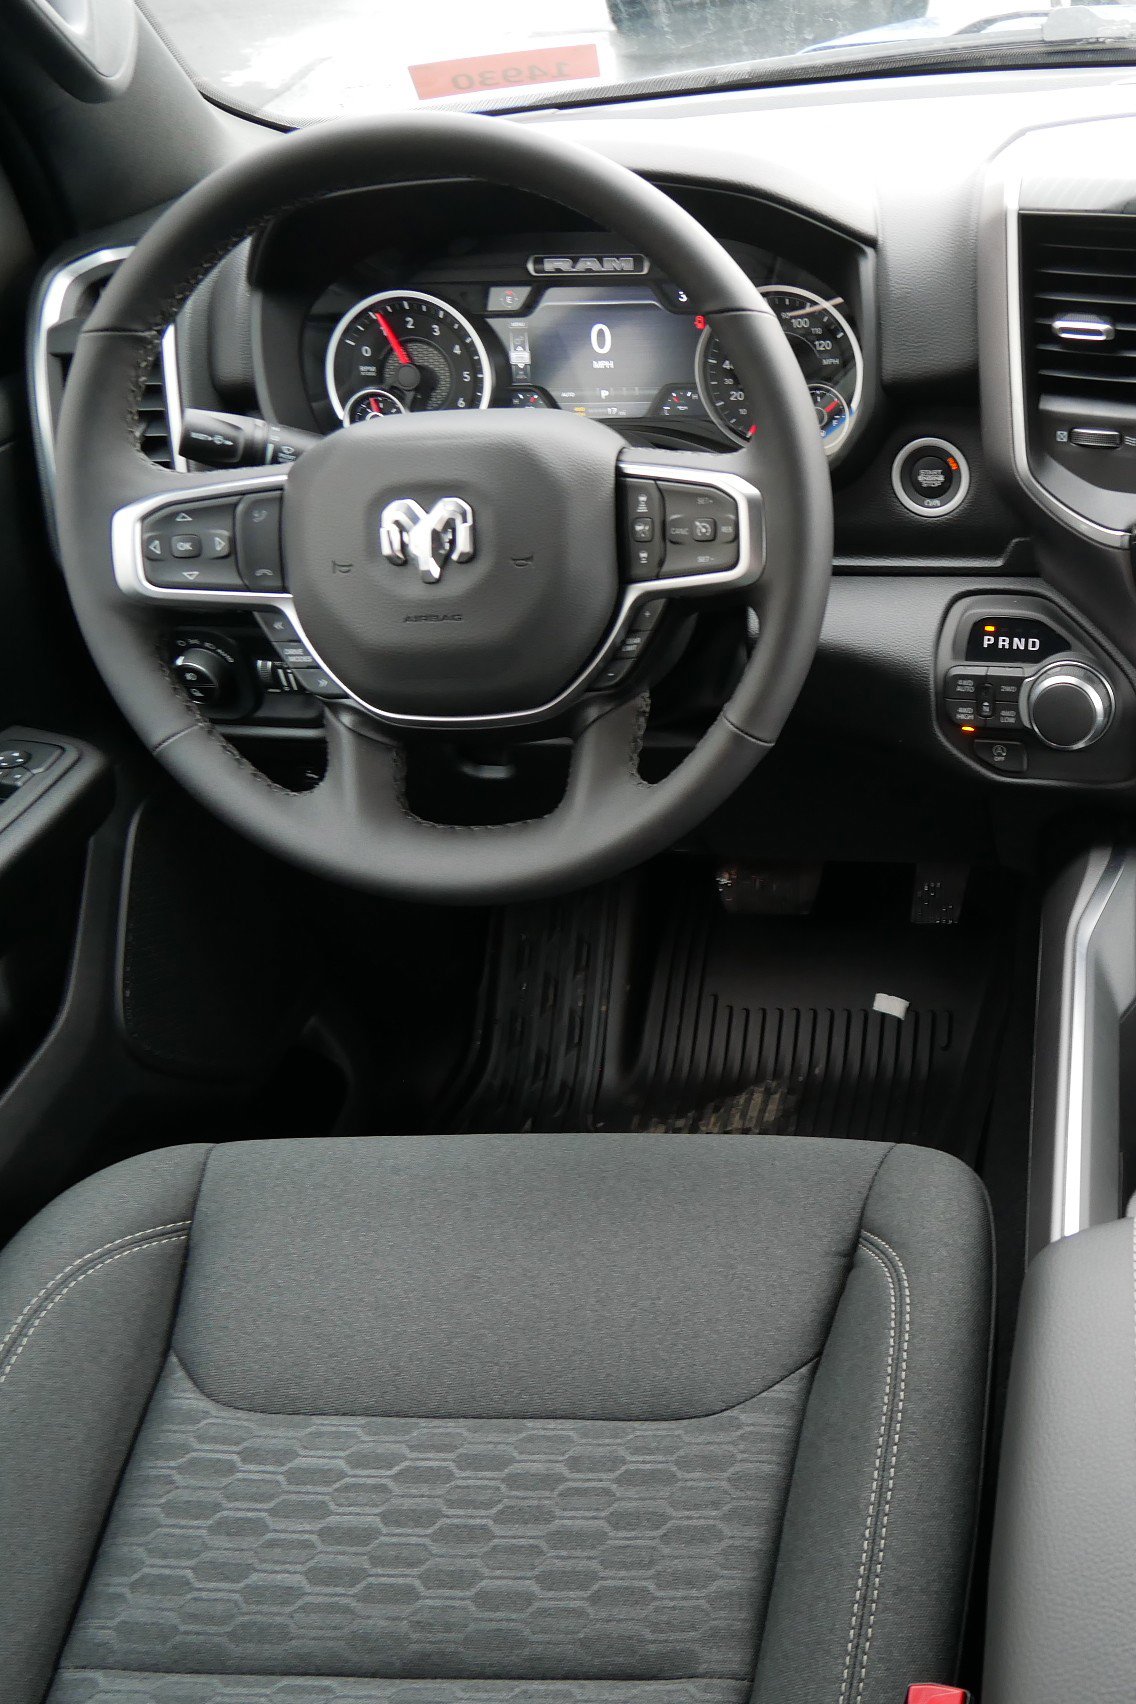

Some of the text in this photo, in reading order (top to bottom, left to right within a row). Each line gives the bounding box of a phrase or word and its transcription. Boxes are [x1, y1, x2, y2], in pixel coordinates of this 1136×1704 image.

[543, 258, 634, 271] RAM
[405, 317, 415, 329] 2
[791, 318, 810, 328] 100
[432, 324, 441, 336] 3
[590, 323, 612, 354] 0
[453, 344, 461, 355] 4
[814, 340, 832, 351] 120
[362, 346, 372, 357] 0
[822, 358, 840, 366] MPH
[462, 371, 471, 382] 5
[729, 391, 745, 401] 20
[457, 399, 466, 408] 6
[176, 542, 193, 550] OK
[403, 614, 463, 622] AIRBAG
